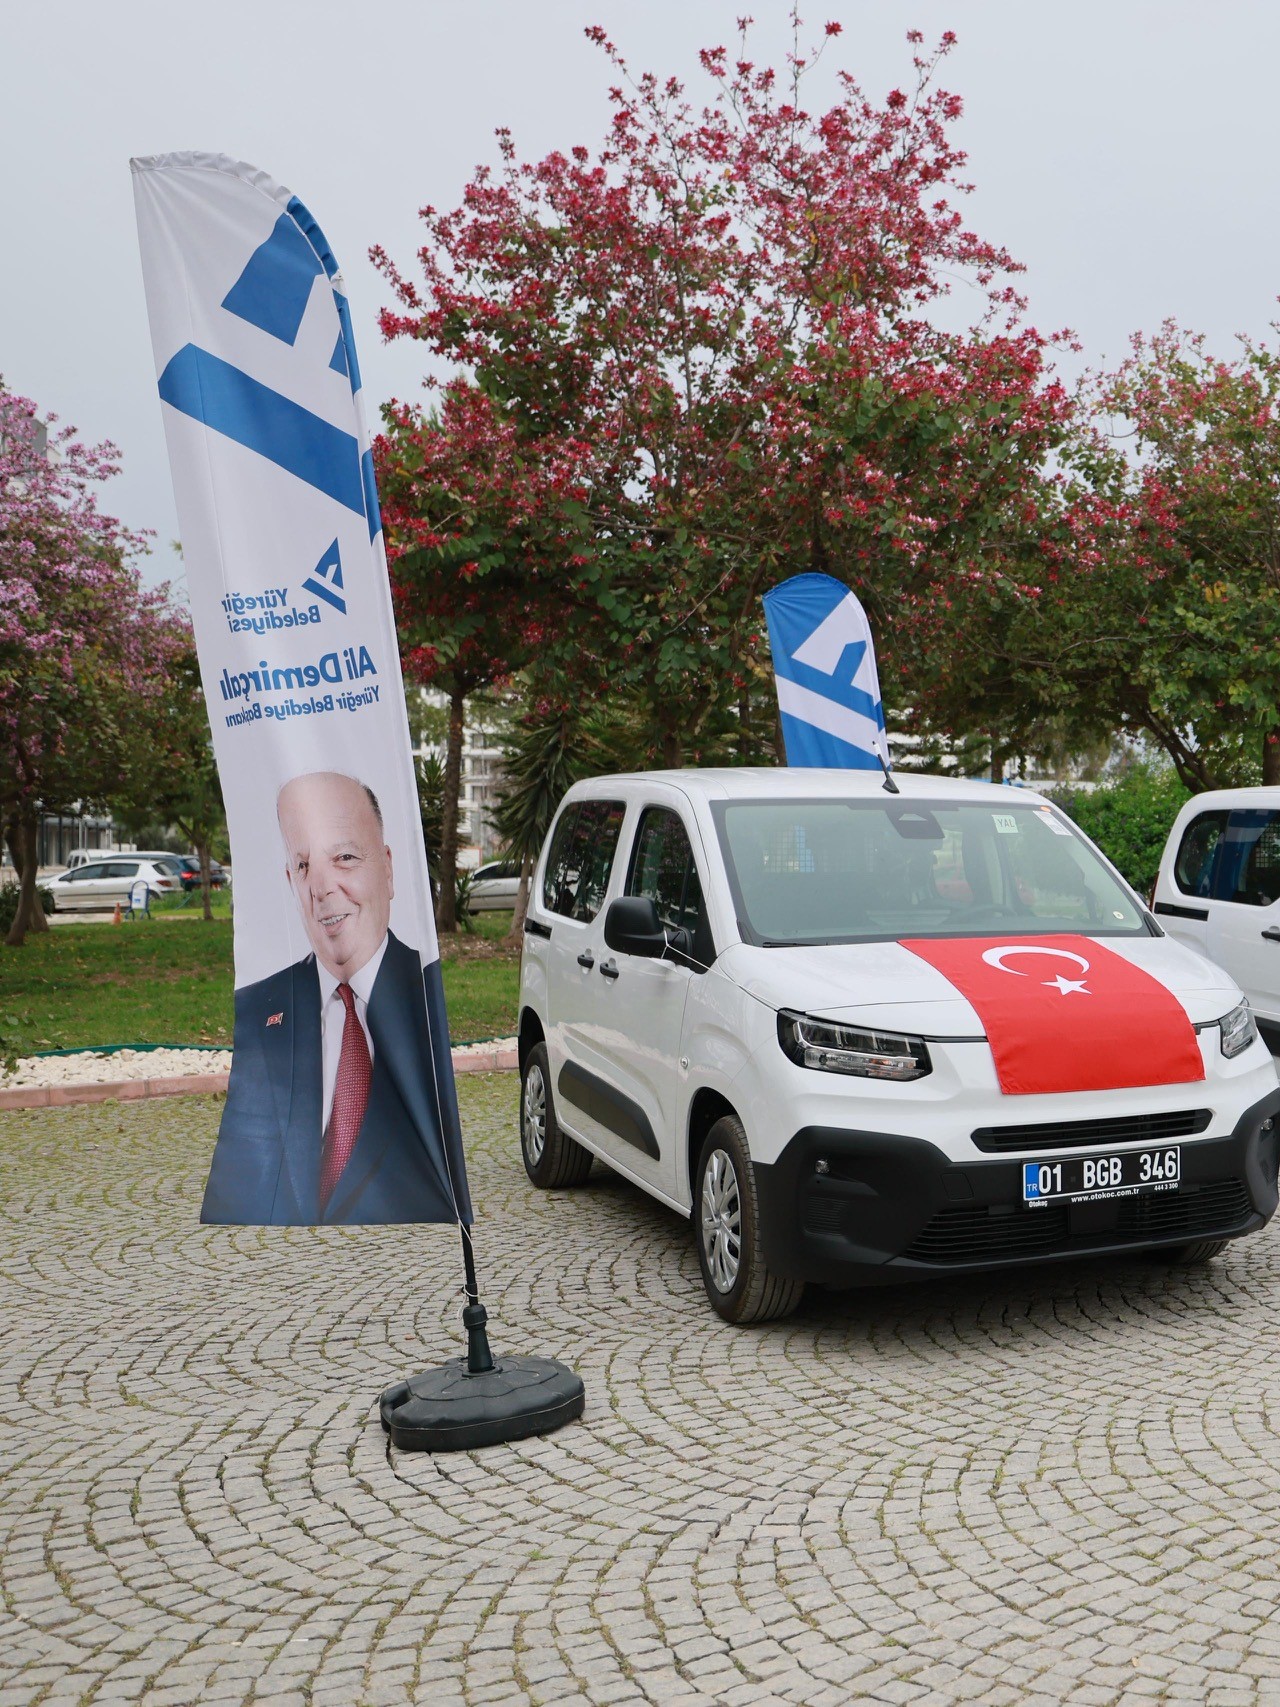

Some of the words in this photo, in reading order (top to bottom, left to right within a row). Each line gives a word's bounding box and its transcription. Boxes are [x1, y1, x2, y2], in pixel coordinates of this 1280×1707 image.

[1027, 1183, 1038, 1192] TR
[1038, 1164, 1062, 1194] 01
[1083, 1158, 1122, 1189] BGB
[1139, 1150, 1177, 1181] 346
[1071, 1188, 1140, 1203] www.otokoc.com.tr
